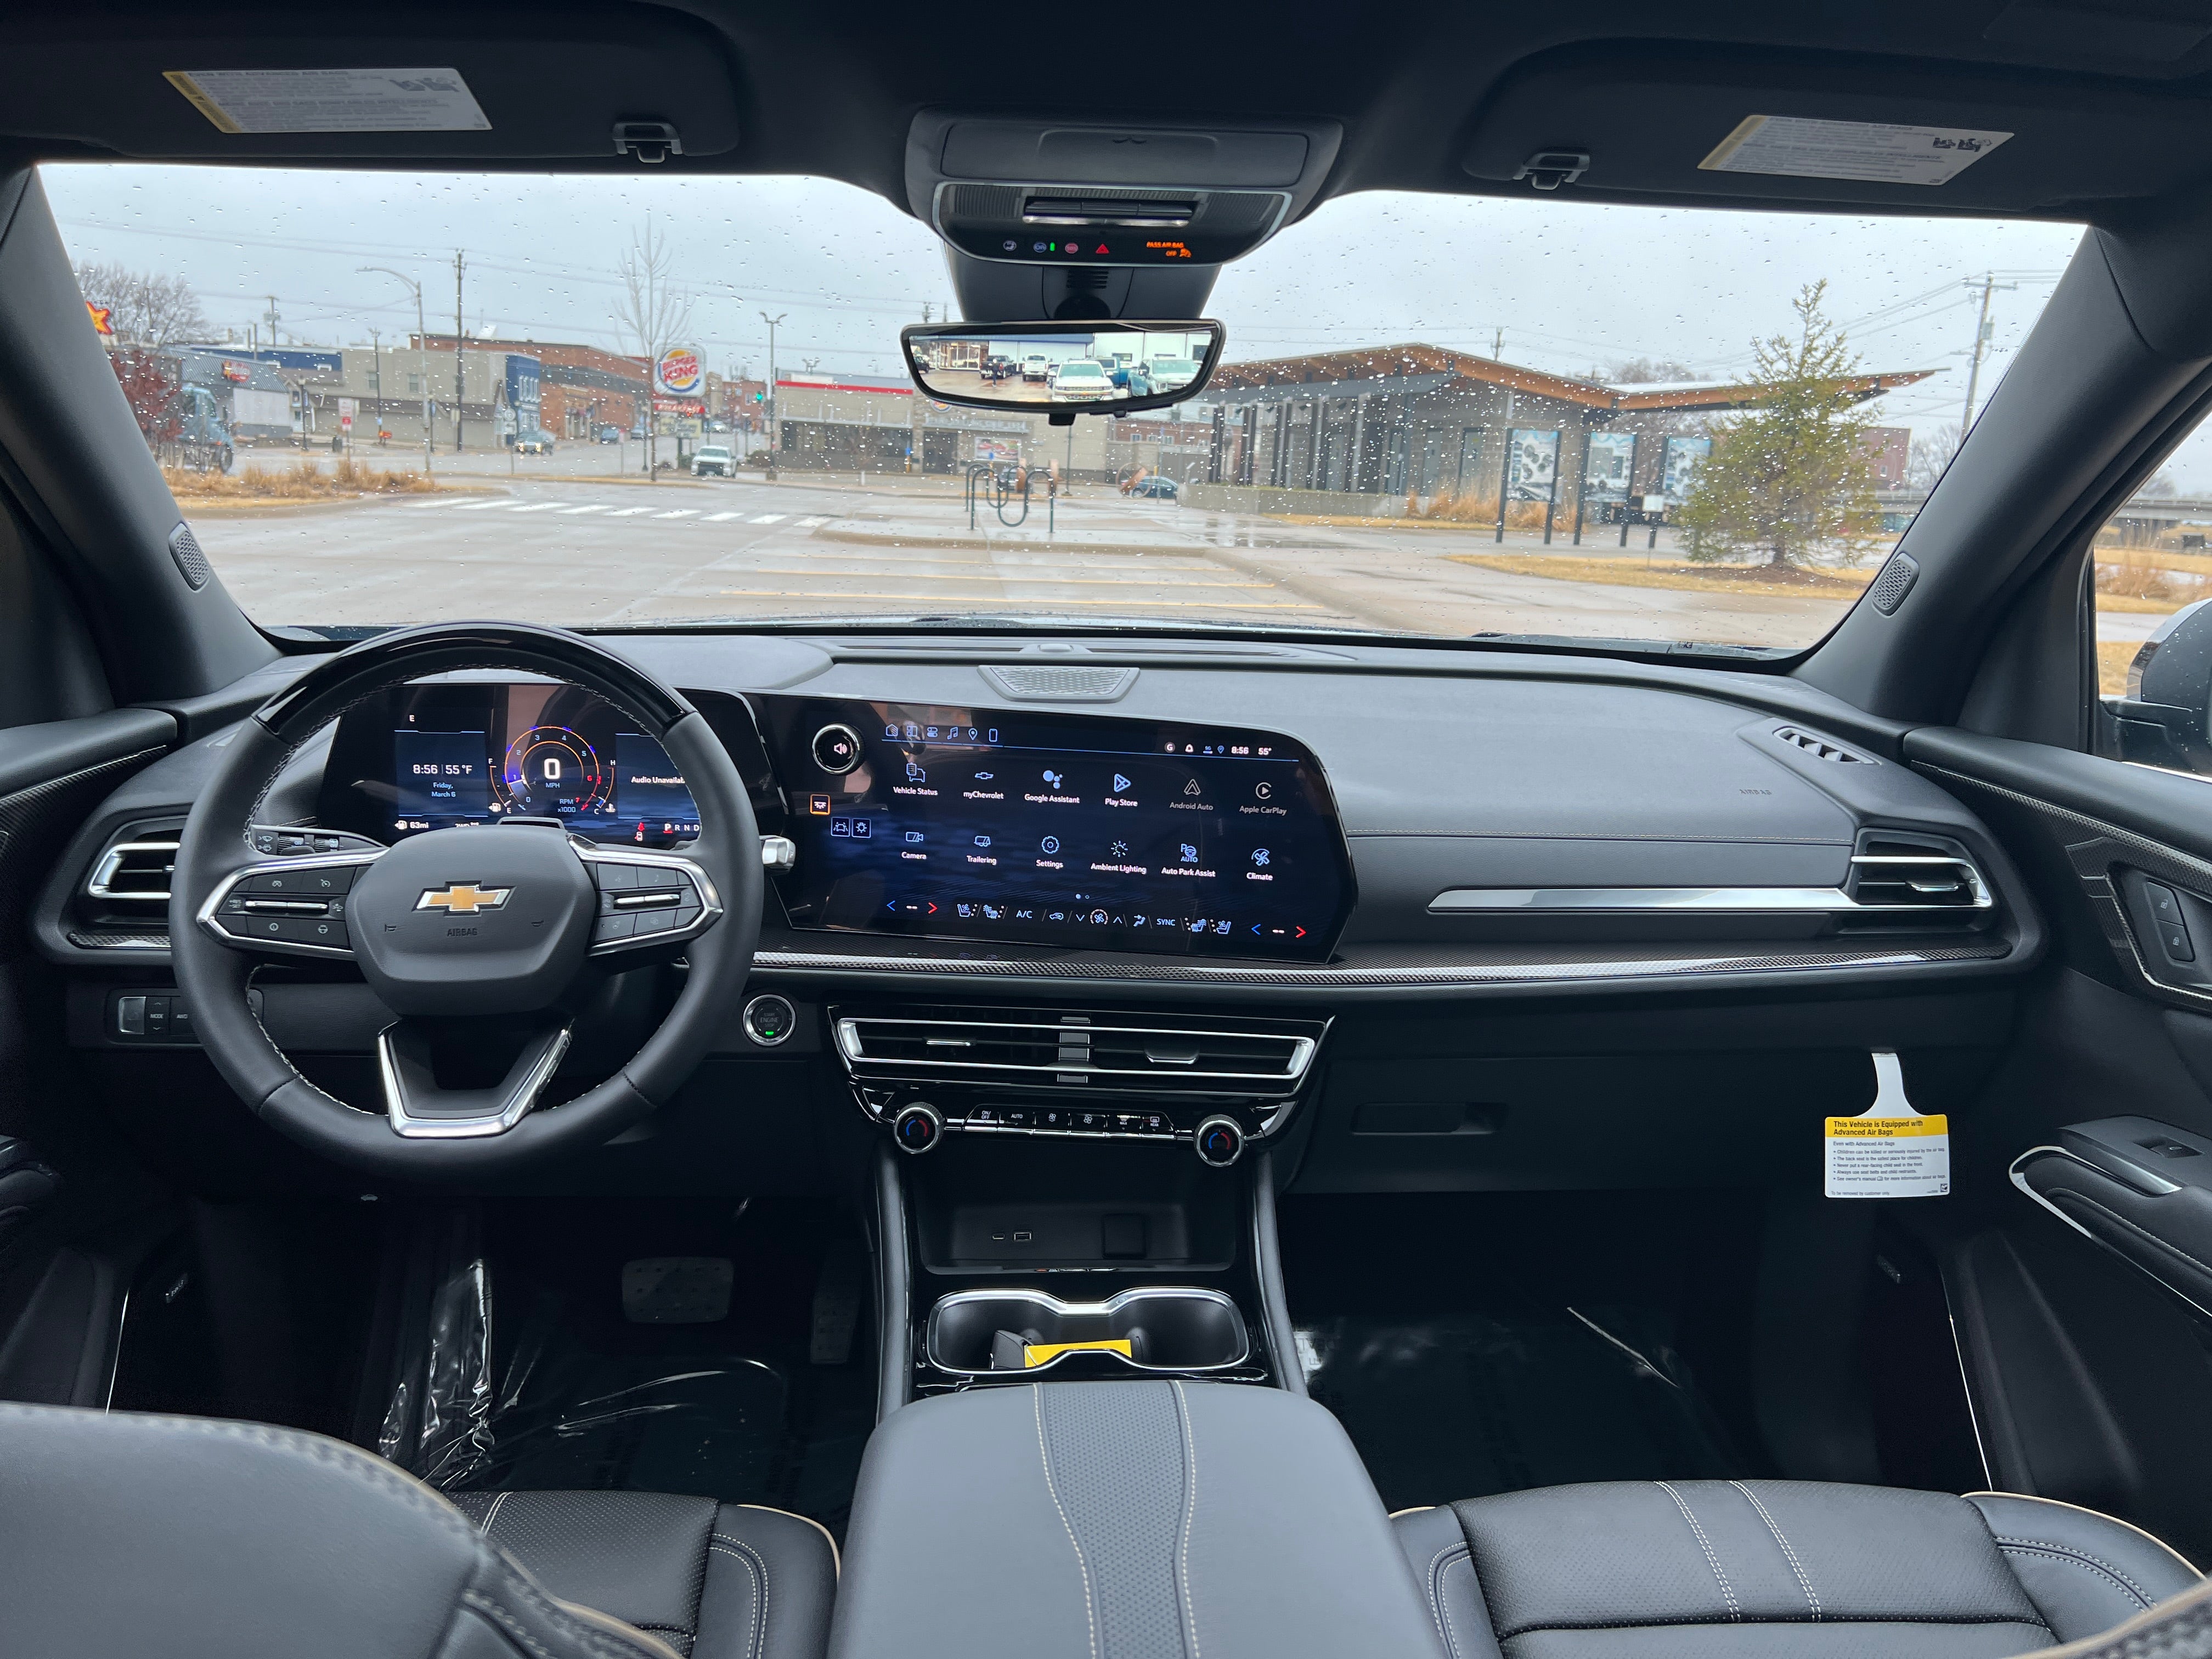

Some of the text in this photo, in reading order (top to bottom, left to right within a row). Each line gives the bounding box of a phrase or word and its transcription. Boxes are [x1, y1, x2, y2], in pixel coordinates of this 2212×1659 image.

[662, 356, 697, 371] BURGER
[663, 364, 698, 382] KING
[1231, 746, 1272, 755] 8:56 55°
[413, 764, 438, 774] 8:56
[544, 758, 561, 780] 0
[893, 786, 916, 794] Vehicle
[963, 791, 1004, 799] myChevrolet
[1024, 793, 1048, 803] Google
[1105, 798, 1119, 807] Play
[1239, 805, 1287, 816] Apple CarPlay
[664, 823, 672, 831] P
[901, 851, 927, 860] Camera
[967, 855, 996, 865] Trailering
[1036, 859, 1063, 869] Settings
[1091, 863, 1147, 874] Ambient Lighting
[1195, 869, 1216, 877] Assist
[1246, 872, 1273, 881] Climate
[1016, 910, 1032, 919] A/C
[447, 928, 478, 937] AIRBAG
